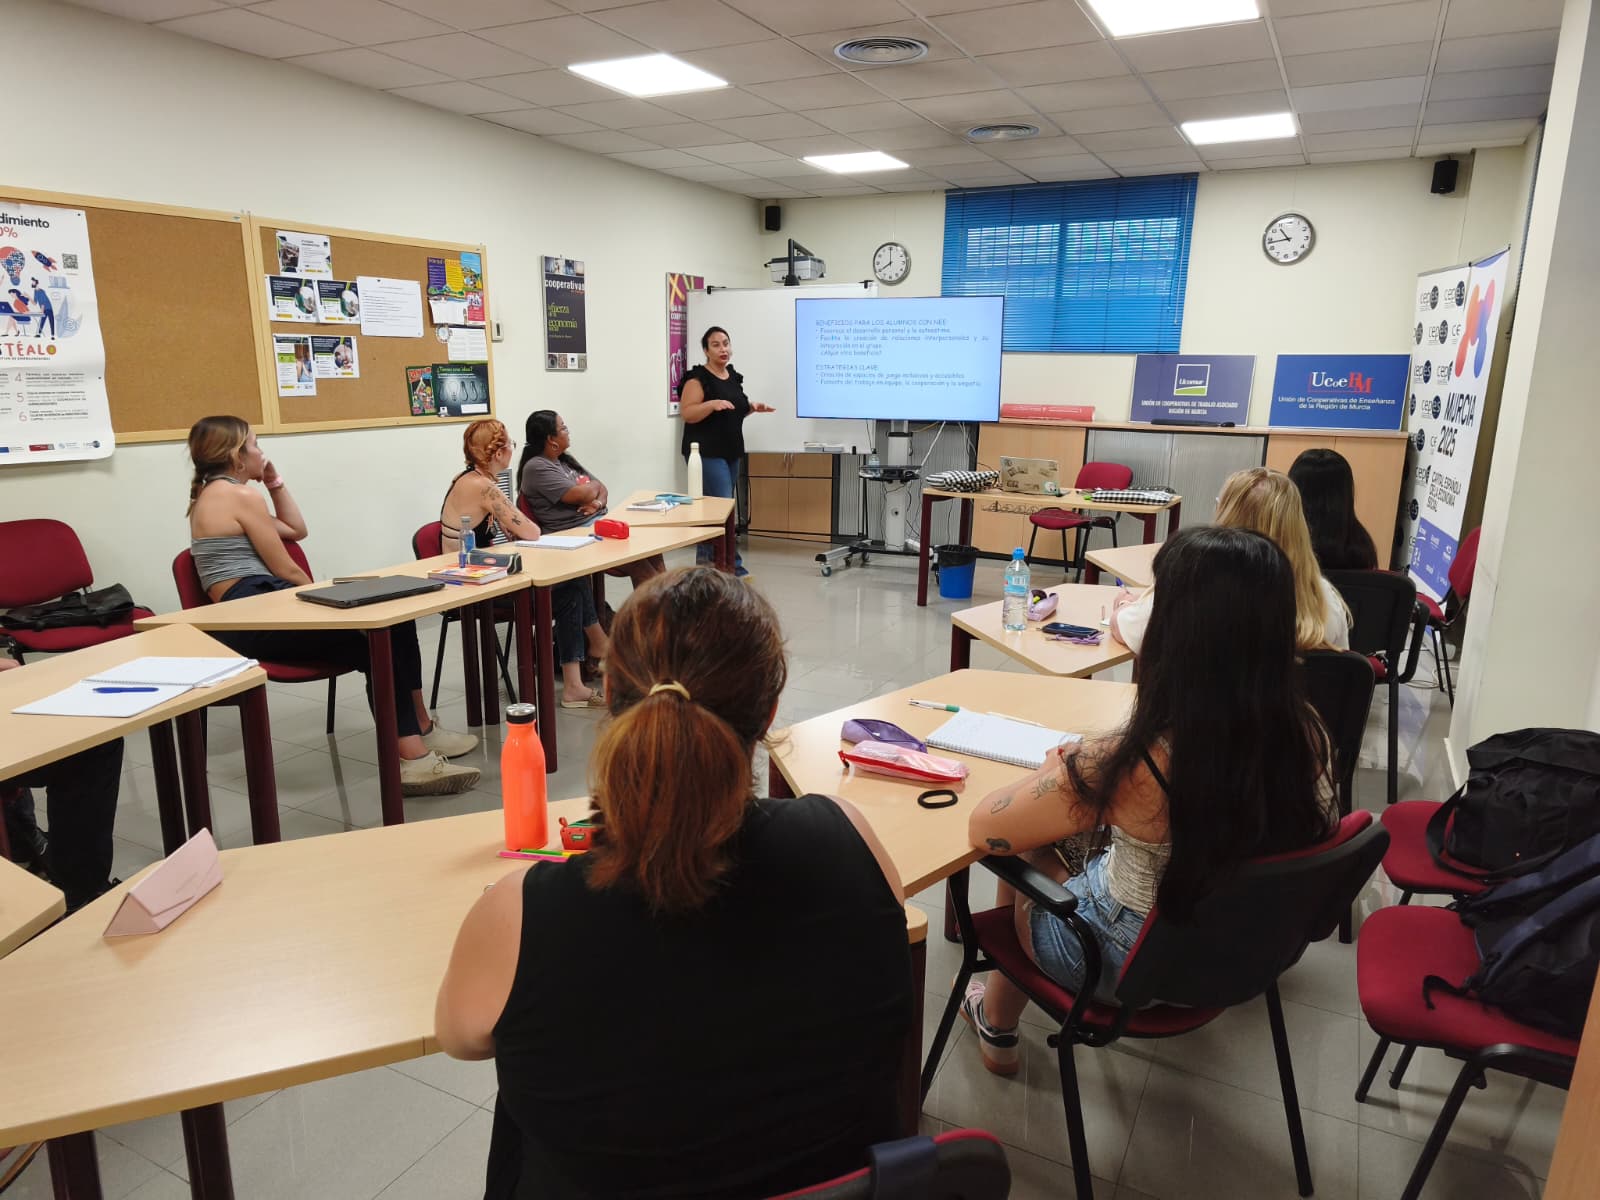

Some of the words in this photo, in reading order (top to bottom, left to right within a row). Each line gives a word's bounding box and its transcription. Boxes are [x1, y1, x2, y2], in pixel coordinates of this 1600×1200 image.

[0, 212, 50, 228] dimiento
[544, 280, 585, 291] cooperativas
[15, 373, 22, 382] 4
[17, 393, 24, 403] 5
[1444, 392, 1476, 427] MURCIA
[1437, 425, 1458, 458] 2025
